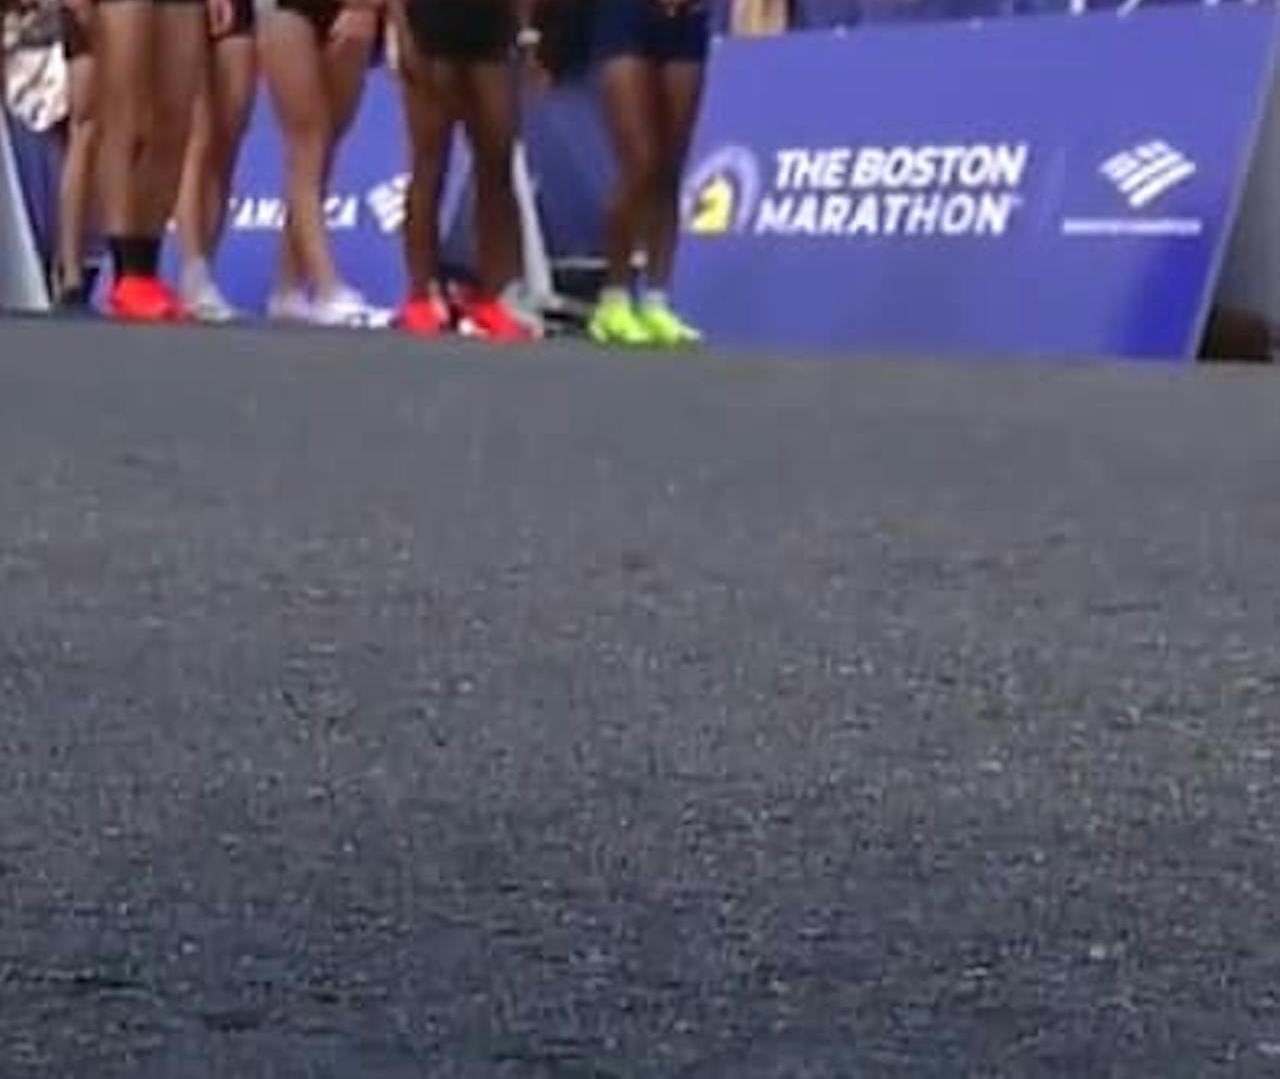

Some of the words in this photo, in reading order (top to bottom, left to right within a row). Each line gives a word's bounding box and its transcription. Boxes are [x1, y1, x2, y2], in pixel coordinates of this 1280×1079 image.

[775, 147, 851, 190] THE
[850, 142, 1028, 188] BOSTON
[233, 197, 359, 231] AMCA
[753, 193, 1013, 236] MARATHON
